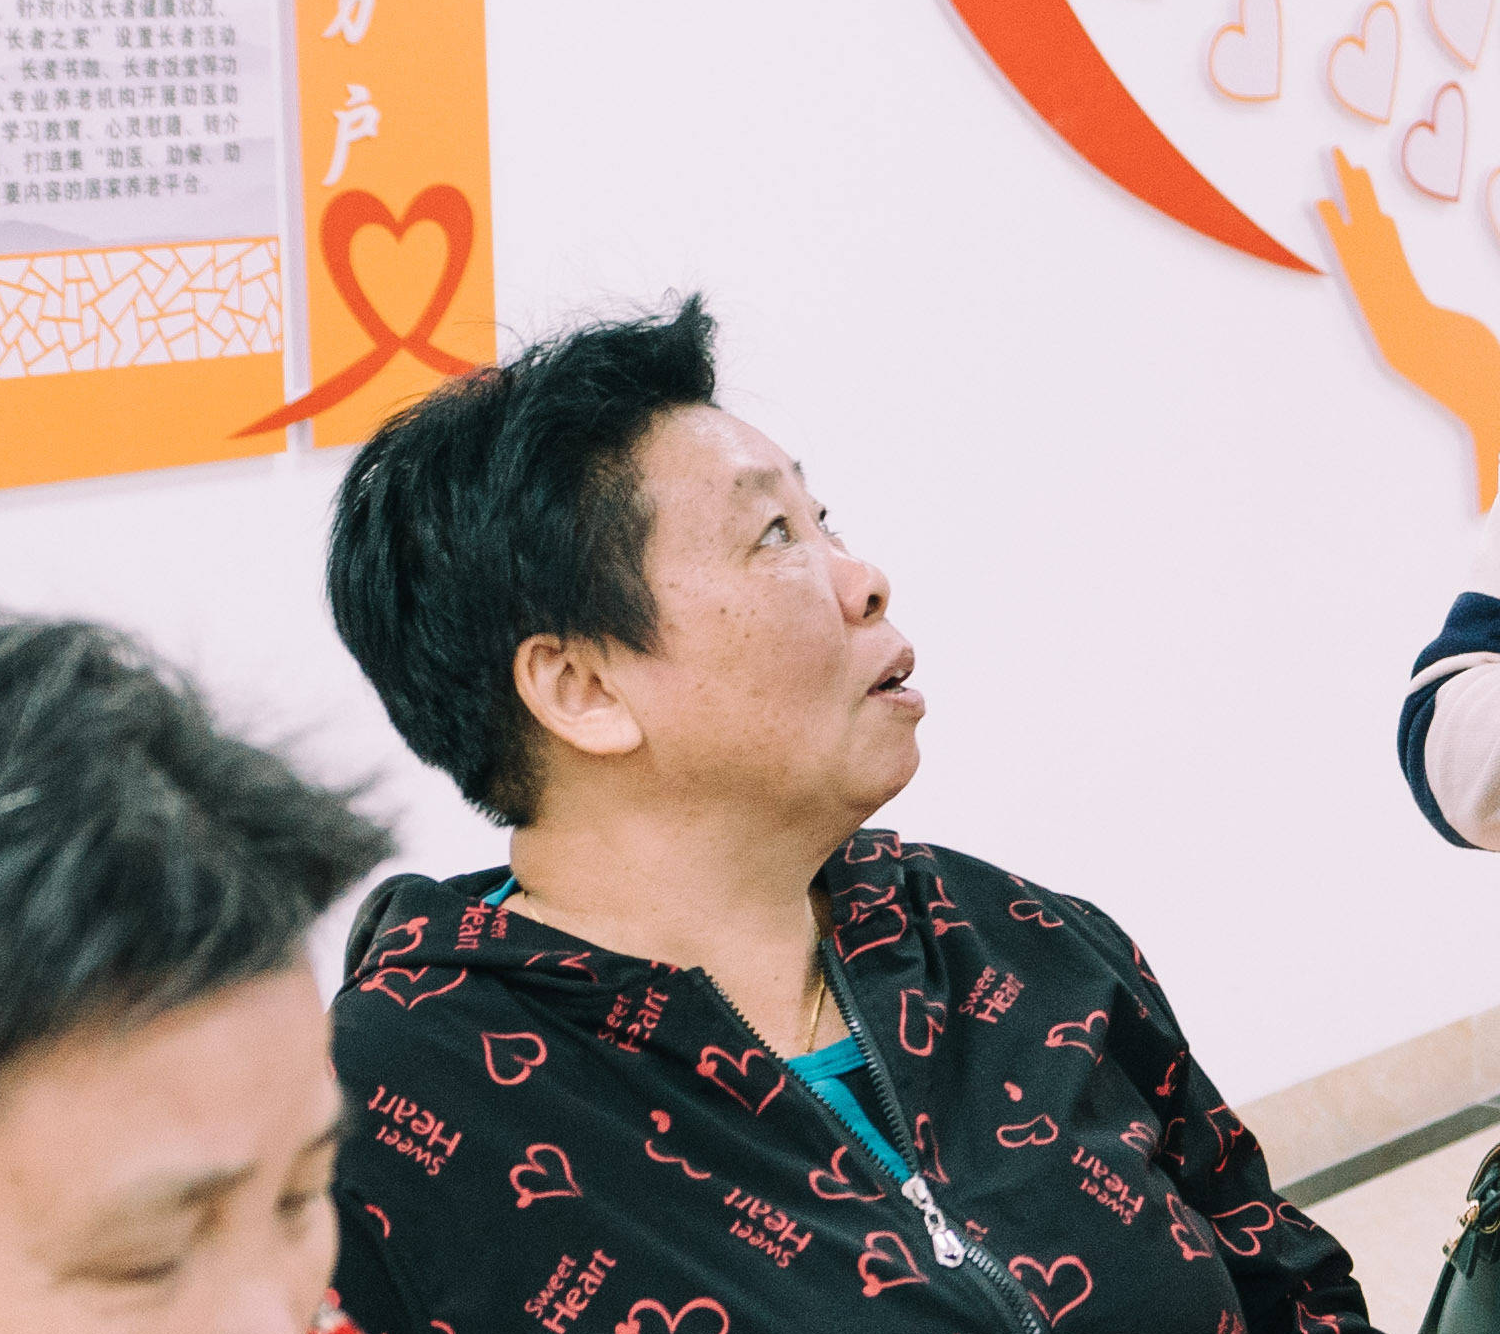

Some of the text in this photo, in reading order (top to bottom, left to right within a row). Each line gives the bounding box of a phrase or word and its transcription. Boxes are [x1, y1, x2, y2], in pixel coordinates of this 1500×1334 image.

[367, 1084, 463, 1157] Heart
[723, 1186, 812, 1253] Heart
[542, 1249, 617, 1334] Heart
